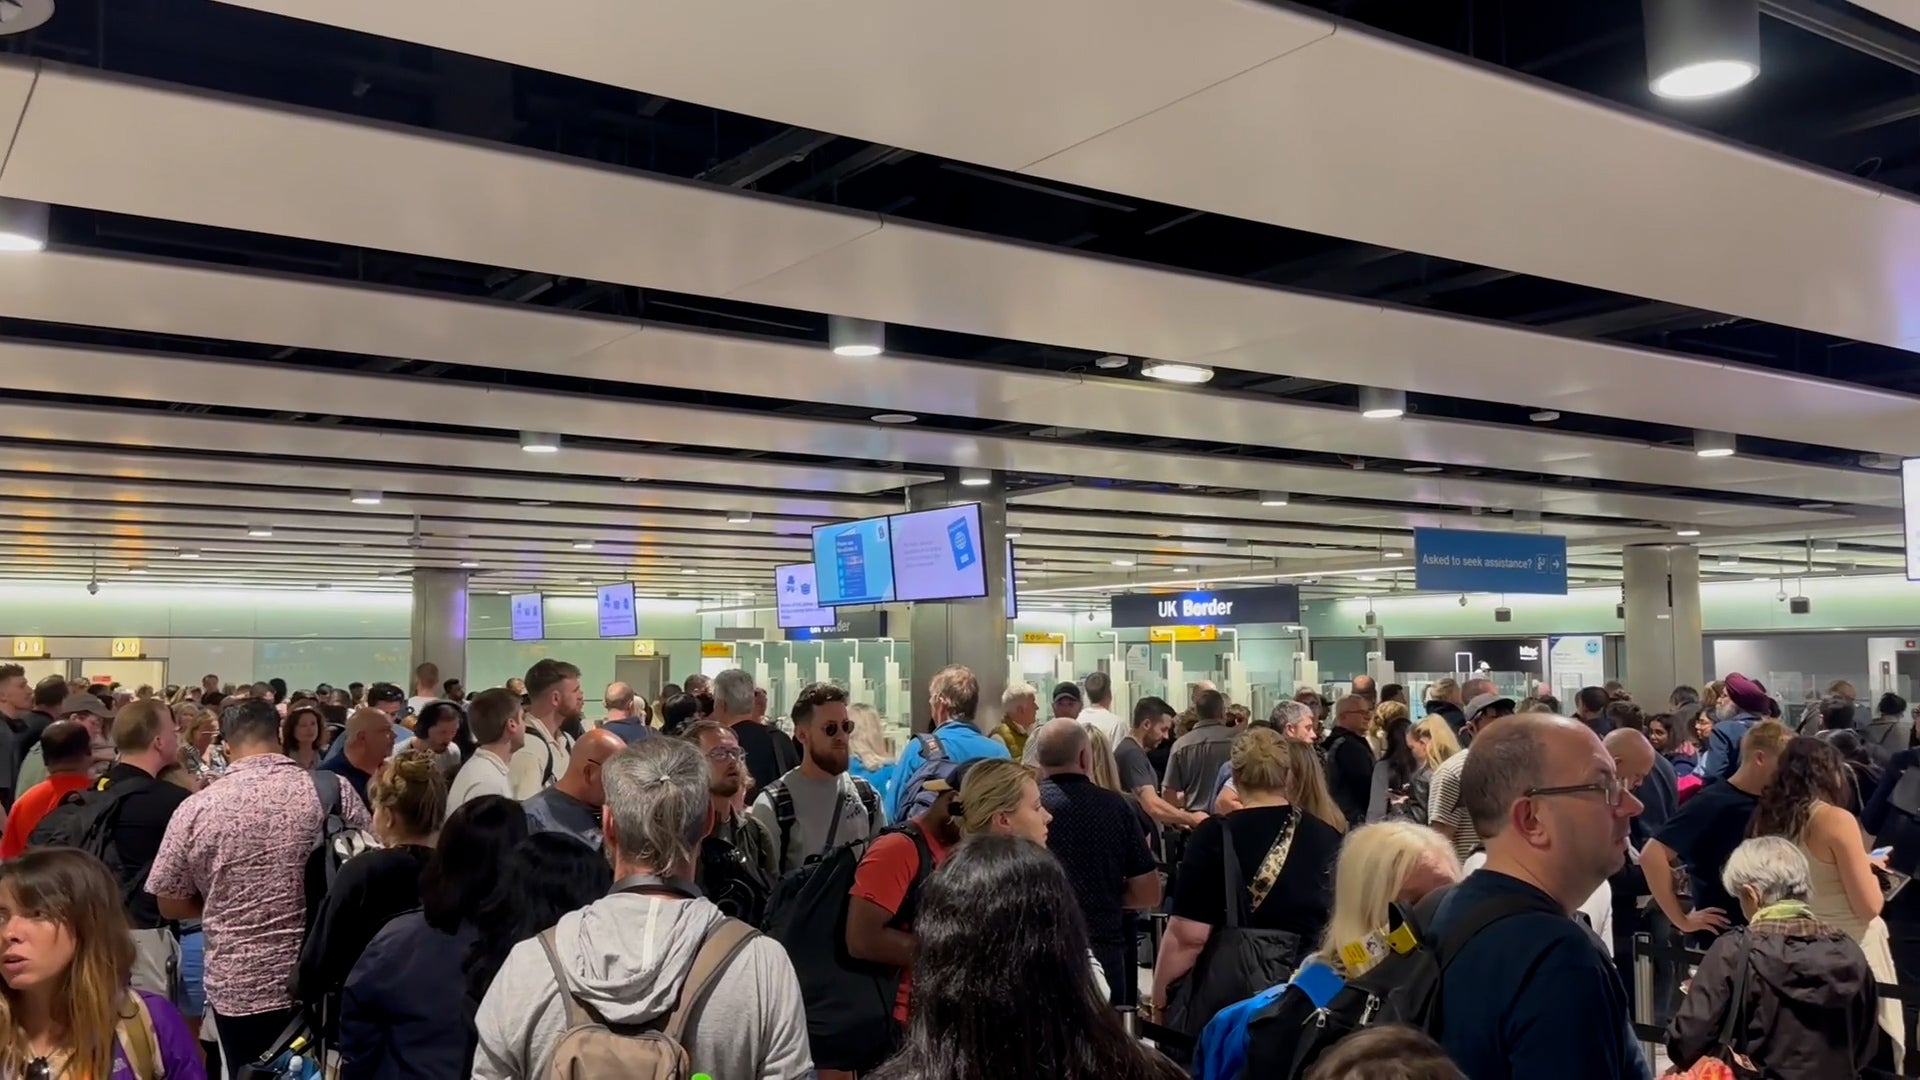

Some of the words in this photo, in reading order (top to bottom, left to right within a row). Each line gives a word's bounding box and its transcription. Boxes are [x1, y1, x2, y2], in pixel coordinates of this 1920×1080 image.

[1422, 554, 1449, 566] Asked
[1451, 555, 1461, 567] to
[1462, 556, 1482, 568] seek
[1484, 558, 1533, 569] assistance?
[1158, 601, 1178, 617] UK
[1183, 599, 1233, 617] Border
